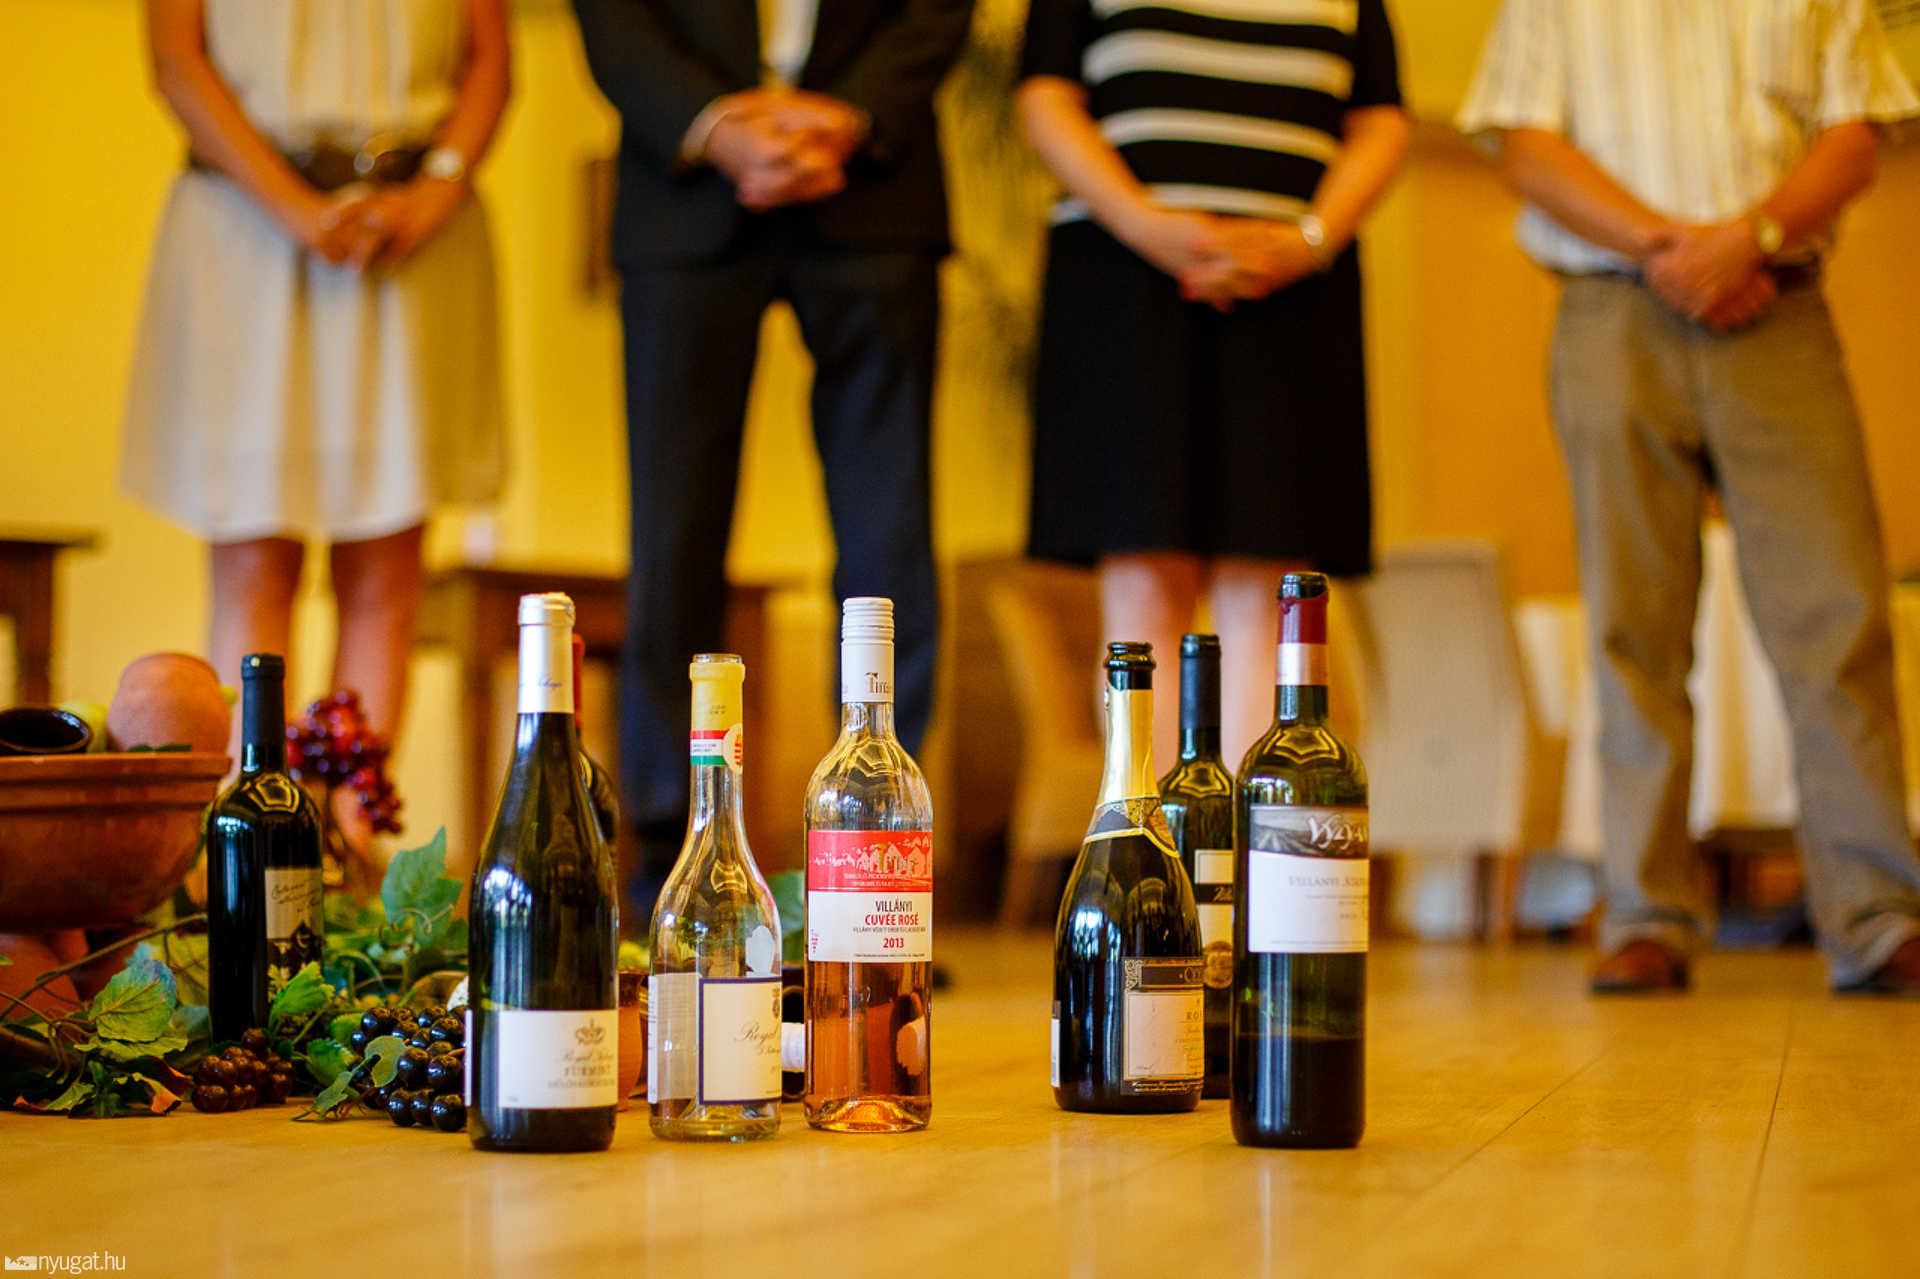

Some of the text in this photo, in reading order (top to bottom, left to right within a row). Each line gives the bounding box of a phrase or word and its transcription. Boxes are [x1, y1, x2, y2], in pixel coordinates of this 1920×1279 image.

[875, 898, 913, 912] VILLÁNYI
[865, 912, 919, 926] CUVÉE ROSÉ
[883, 937, 904, 948] 2013
